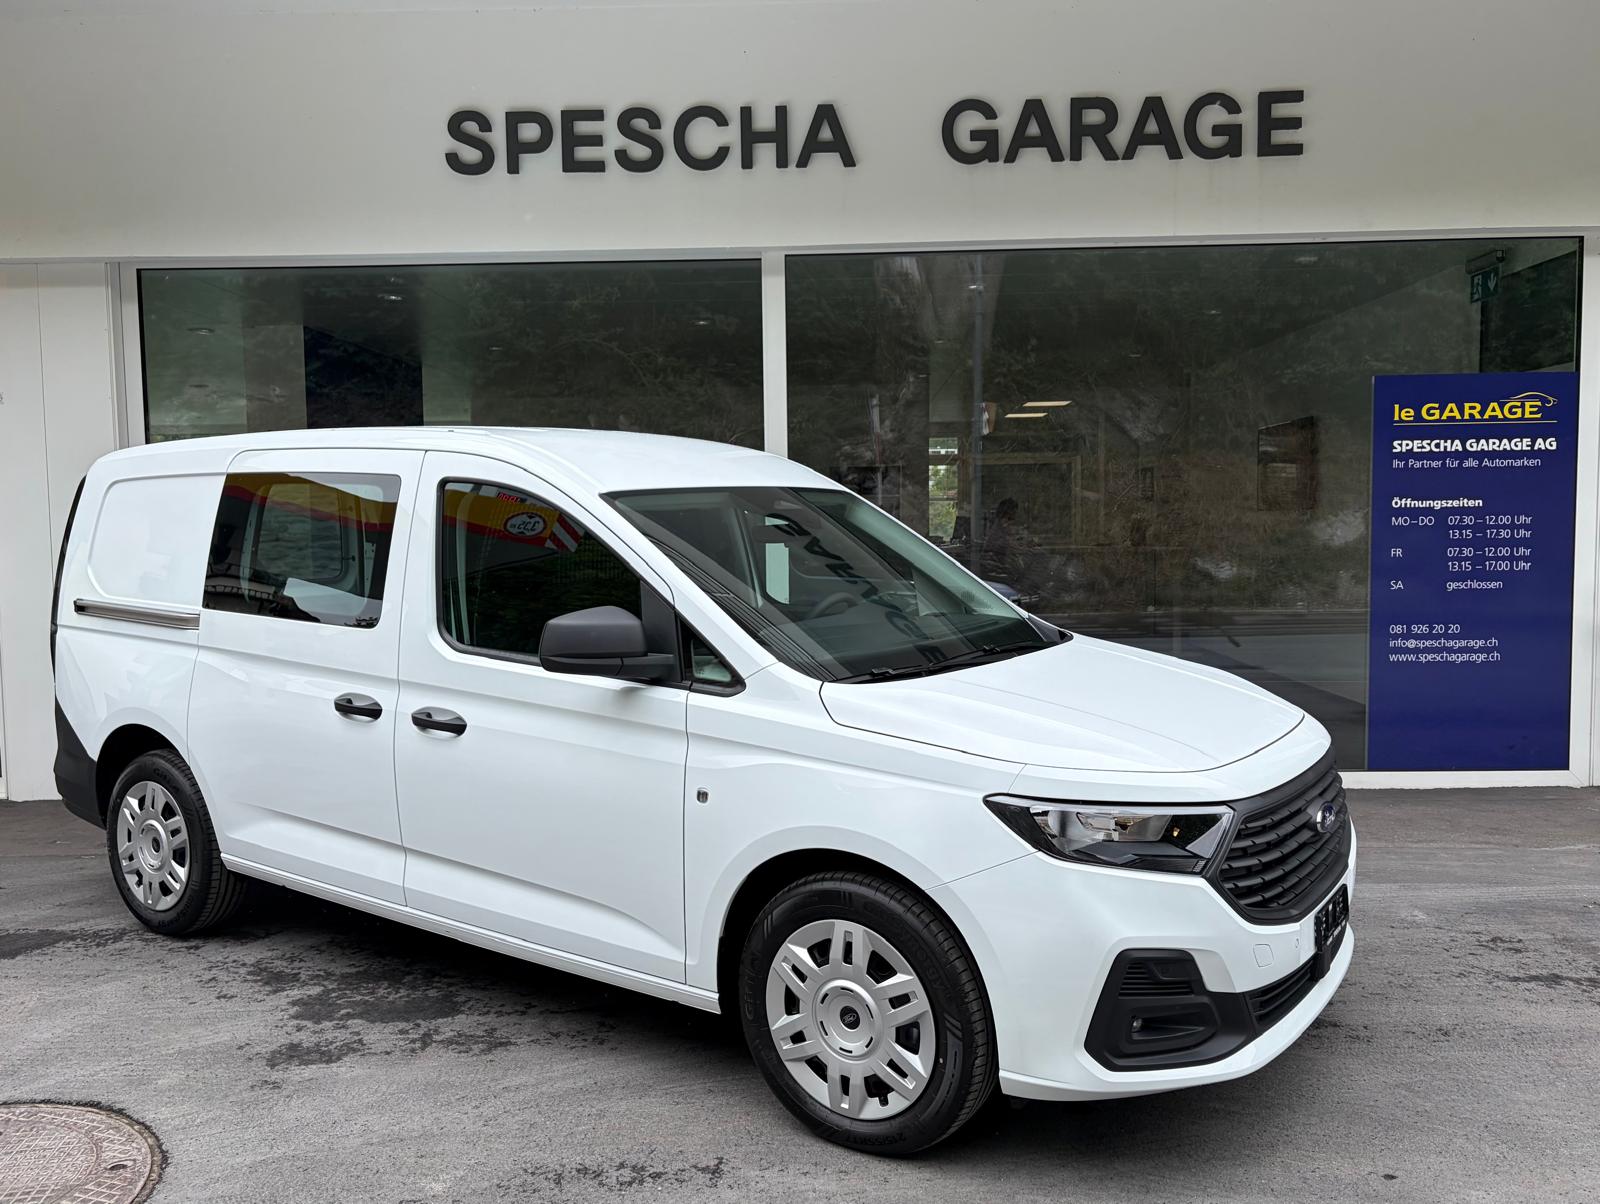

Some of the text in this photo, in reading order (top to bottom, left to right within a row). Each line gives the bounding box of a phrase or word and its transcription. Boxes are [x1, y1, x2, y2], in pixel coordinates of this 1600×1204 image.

[445, 90, 1304, 175] SPESCHA GARAGE
[1393, 401, 1543, 421] le GARAGE
[1392, 437, 1557, 453] SPESCHA GARAGE AG
[1392, 456, 1541, 469] Ihr Partner für alle Automarken
[1391, 496, 1483, 510] Öffnungszeiten
[1447, 515, 1475, 526] 07.30
[1485, 515, 1512, 525] 12.00
[1514, 514, 1533, 525] Uhr
[1448, 529, 1473, 540] 13.15
[1486, 528, 1512, 539] 17.30
[1514, 528, 1533, 539] Uhr
[1390, 548, 1403, 558] FR
[1447, 547, 1474, 557] 07.30
[1484, 546, 1511, 557] 12.00
[1513, 546, 1532, 557] Uhr
[1447, 560, 1472, 572] 13.15
[1485, 560, 1511, 571] 17.00
[1513, 560, 1532, 571] Uhr
[1390, 579, 1503, 592] SA geschlossen
[1389, 623, 1461, 634] 081 926 20 20
[1389, 636, 1499, 650] info@speschagarage.ch
[1388, 650, 1501, 664] www.speschagarage.ch
